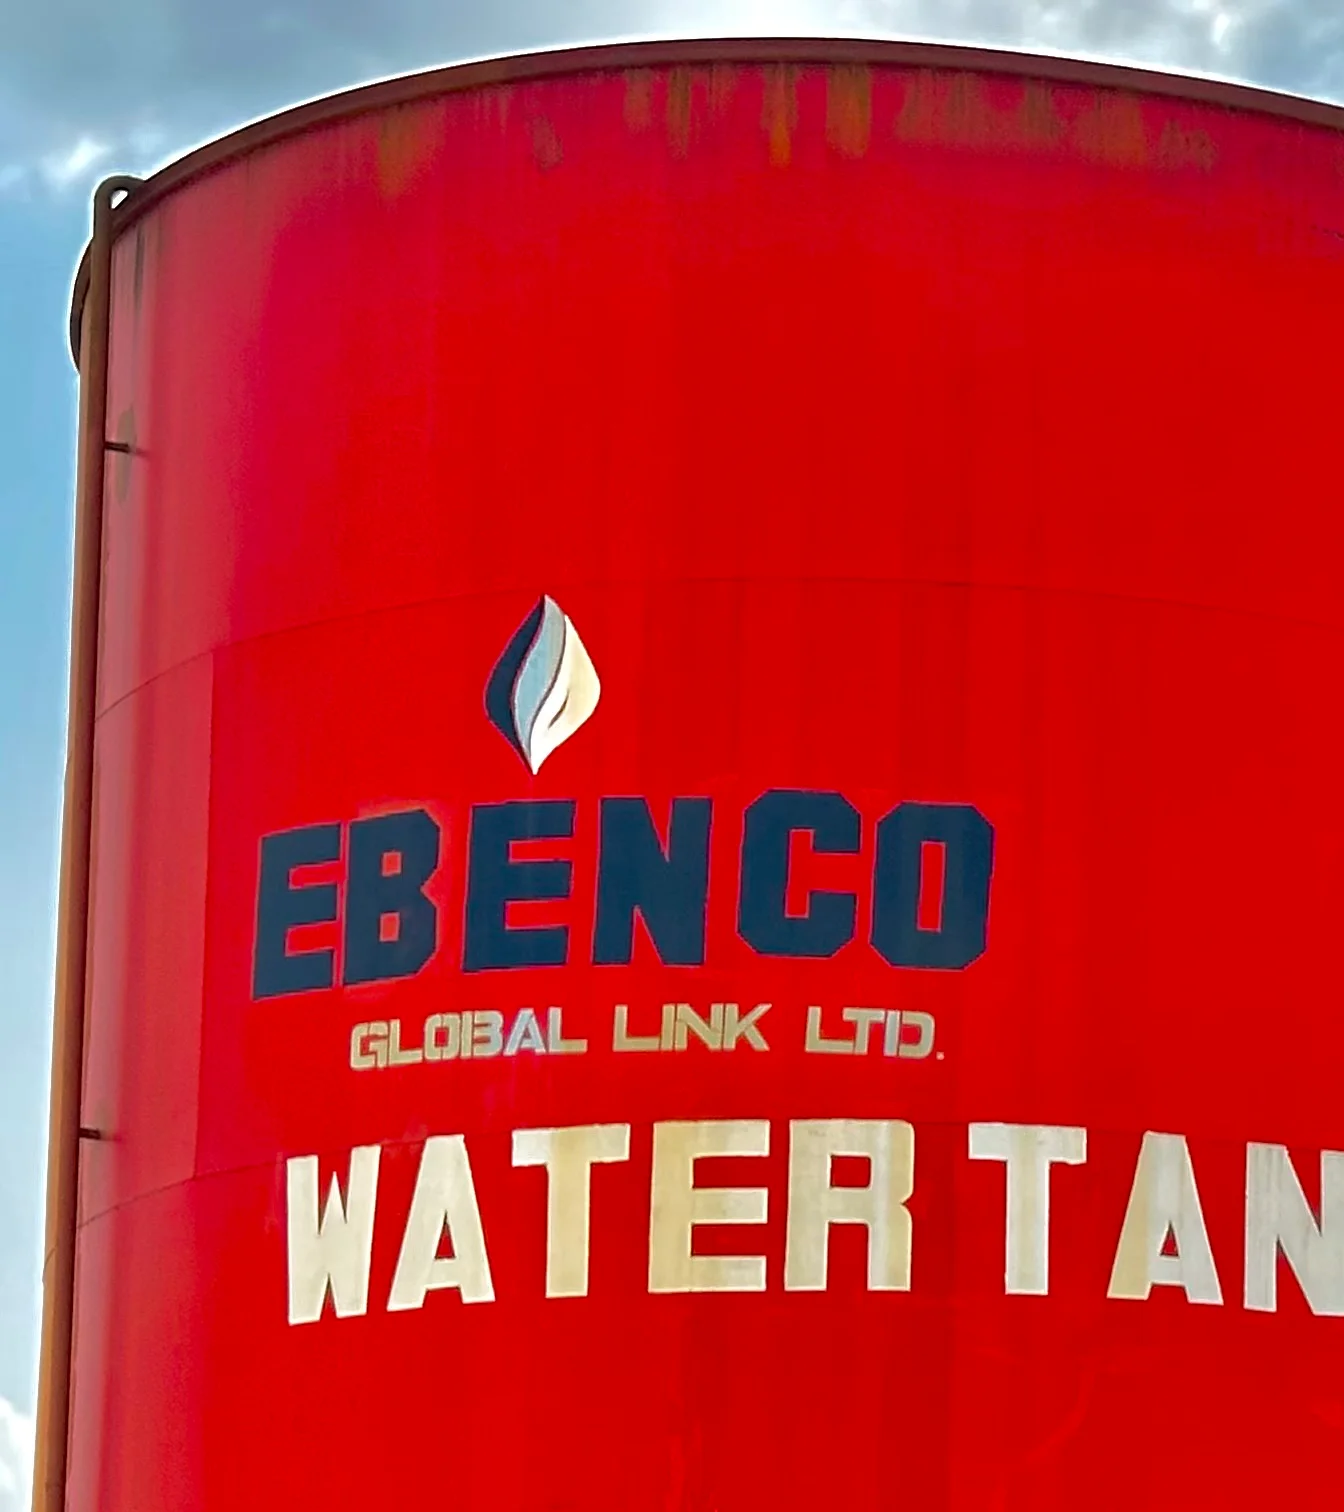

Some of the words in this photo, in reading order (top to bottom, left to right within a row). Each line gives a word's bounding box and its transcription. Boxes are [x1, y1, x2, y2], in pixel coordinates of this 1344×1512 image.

[253, 788, 995, 1001] EBENCO
[350, 1007, 588, 1070] GLOBAL
[613, 1003, 772, 1052] LINK
[804, 1005, 944, 1060] LTD.
[286, 1119, 915, 1326] WATER
